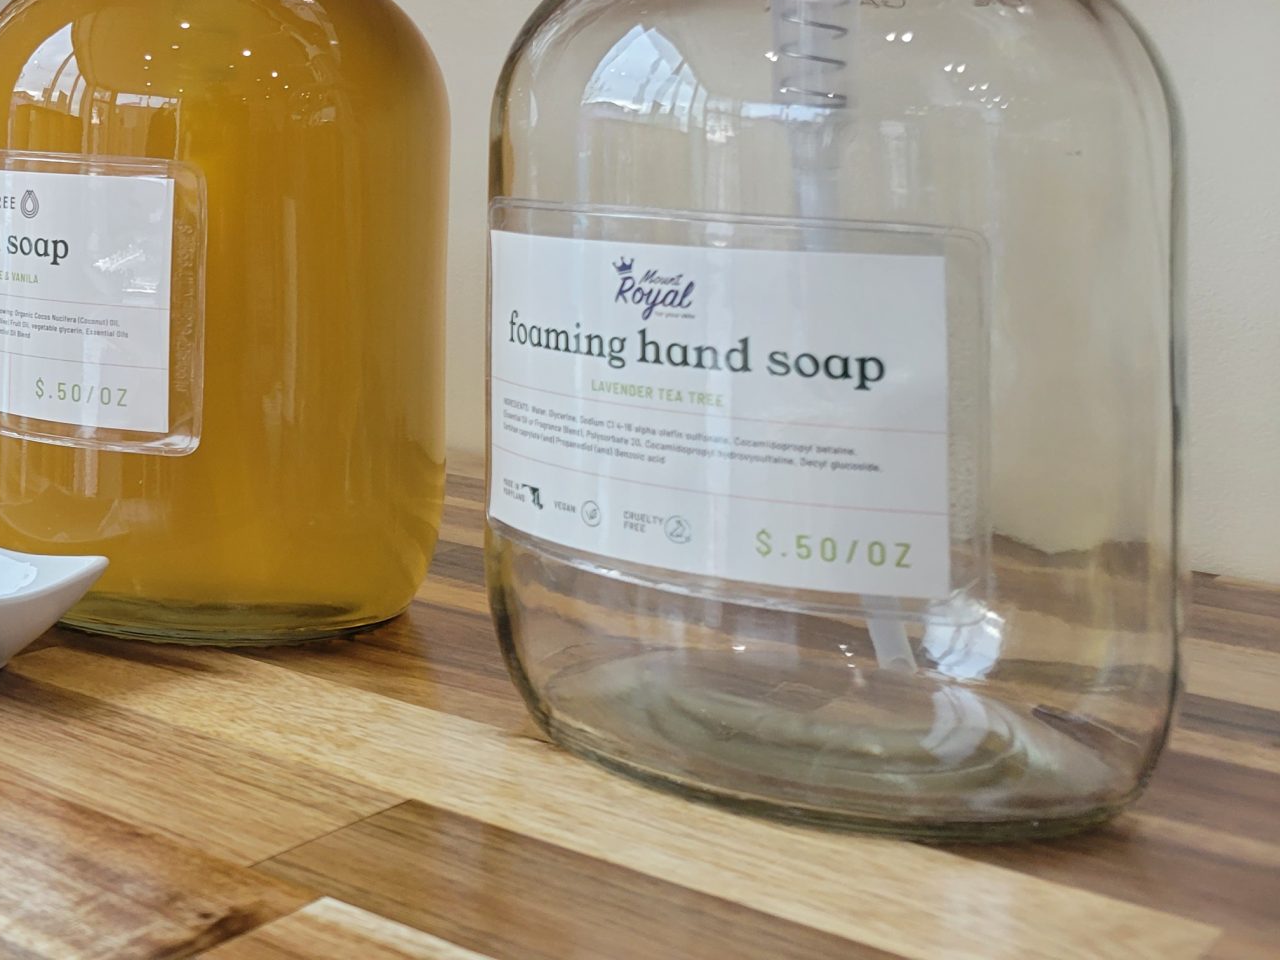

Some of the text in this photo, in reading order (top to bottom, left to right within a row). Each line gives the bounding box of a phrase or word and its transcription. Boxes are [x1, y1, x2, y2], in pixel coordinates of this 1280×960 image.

[7, 235, 69, 266] soap
[4, 272, 9, 281] &
[11, 272, 38, 284] VANILA
[638, 269, 684, 286] Mount
[615, 276, 695, 321] Royal
[14, 310, 108, 327] Organic Cocos Nucifera (Coconut)
[17, 330, 31, 338] Blend
[32, 323, 57, 332] vegetable
[85, 327, 115, 338] Essential
[116, 329, 128, 338] Oils
[508, 310, 886, 391] foaming hand soap
[35, 376, 128, 407] $.50/OZ
[591, 379, 724, 407] LAVENDER TEA TREE
[580, 415, 813, 454] Sodium alpha olefin Cocamidopropyl
[586, 429, 629, 445] Polysorbate
[799, 457, 828, 470] Decyl
[615, 449, 645, 461] Benzoic
[647, 455, 666, 464] acid
[554, 501, 576, 513] VEGAN
[623, 511, 664, 526] CRUELTY
[623, 521, 647, 533] FREE
[755, 529, 912, 569] $.50/OZ
